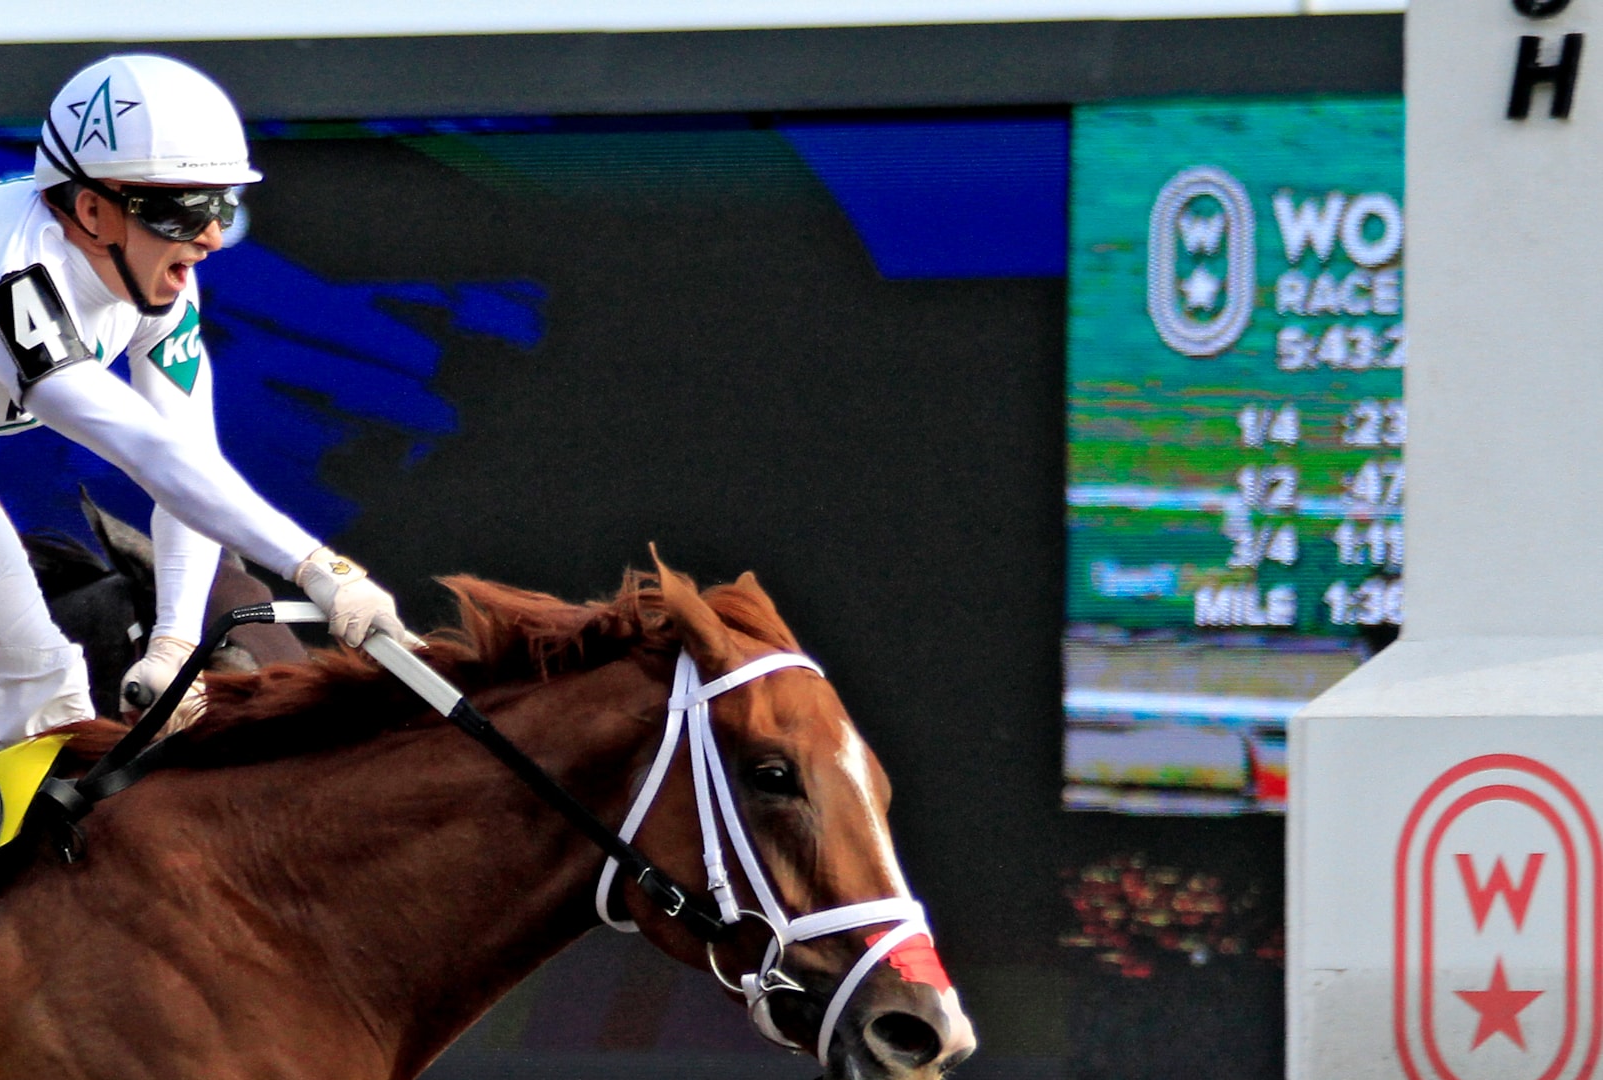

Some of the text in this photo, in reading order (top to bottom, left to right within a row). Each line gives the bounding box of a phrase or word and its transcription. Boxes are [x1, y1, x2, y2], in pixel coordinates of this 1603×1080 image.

[11, 277, 68, 362] 4
[1276, 271, 1400, 316] RACE
[1454, 853, 1546, 934] W
